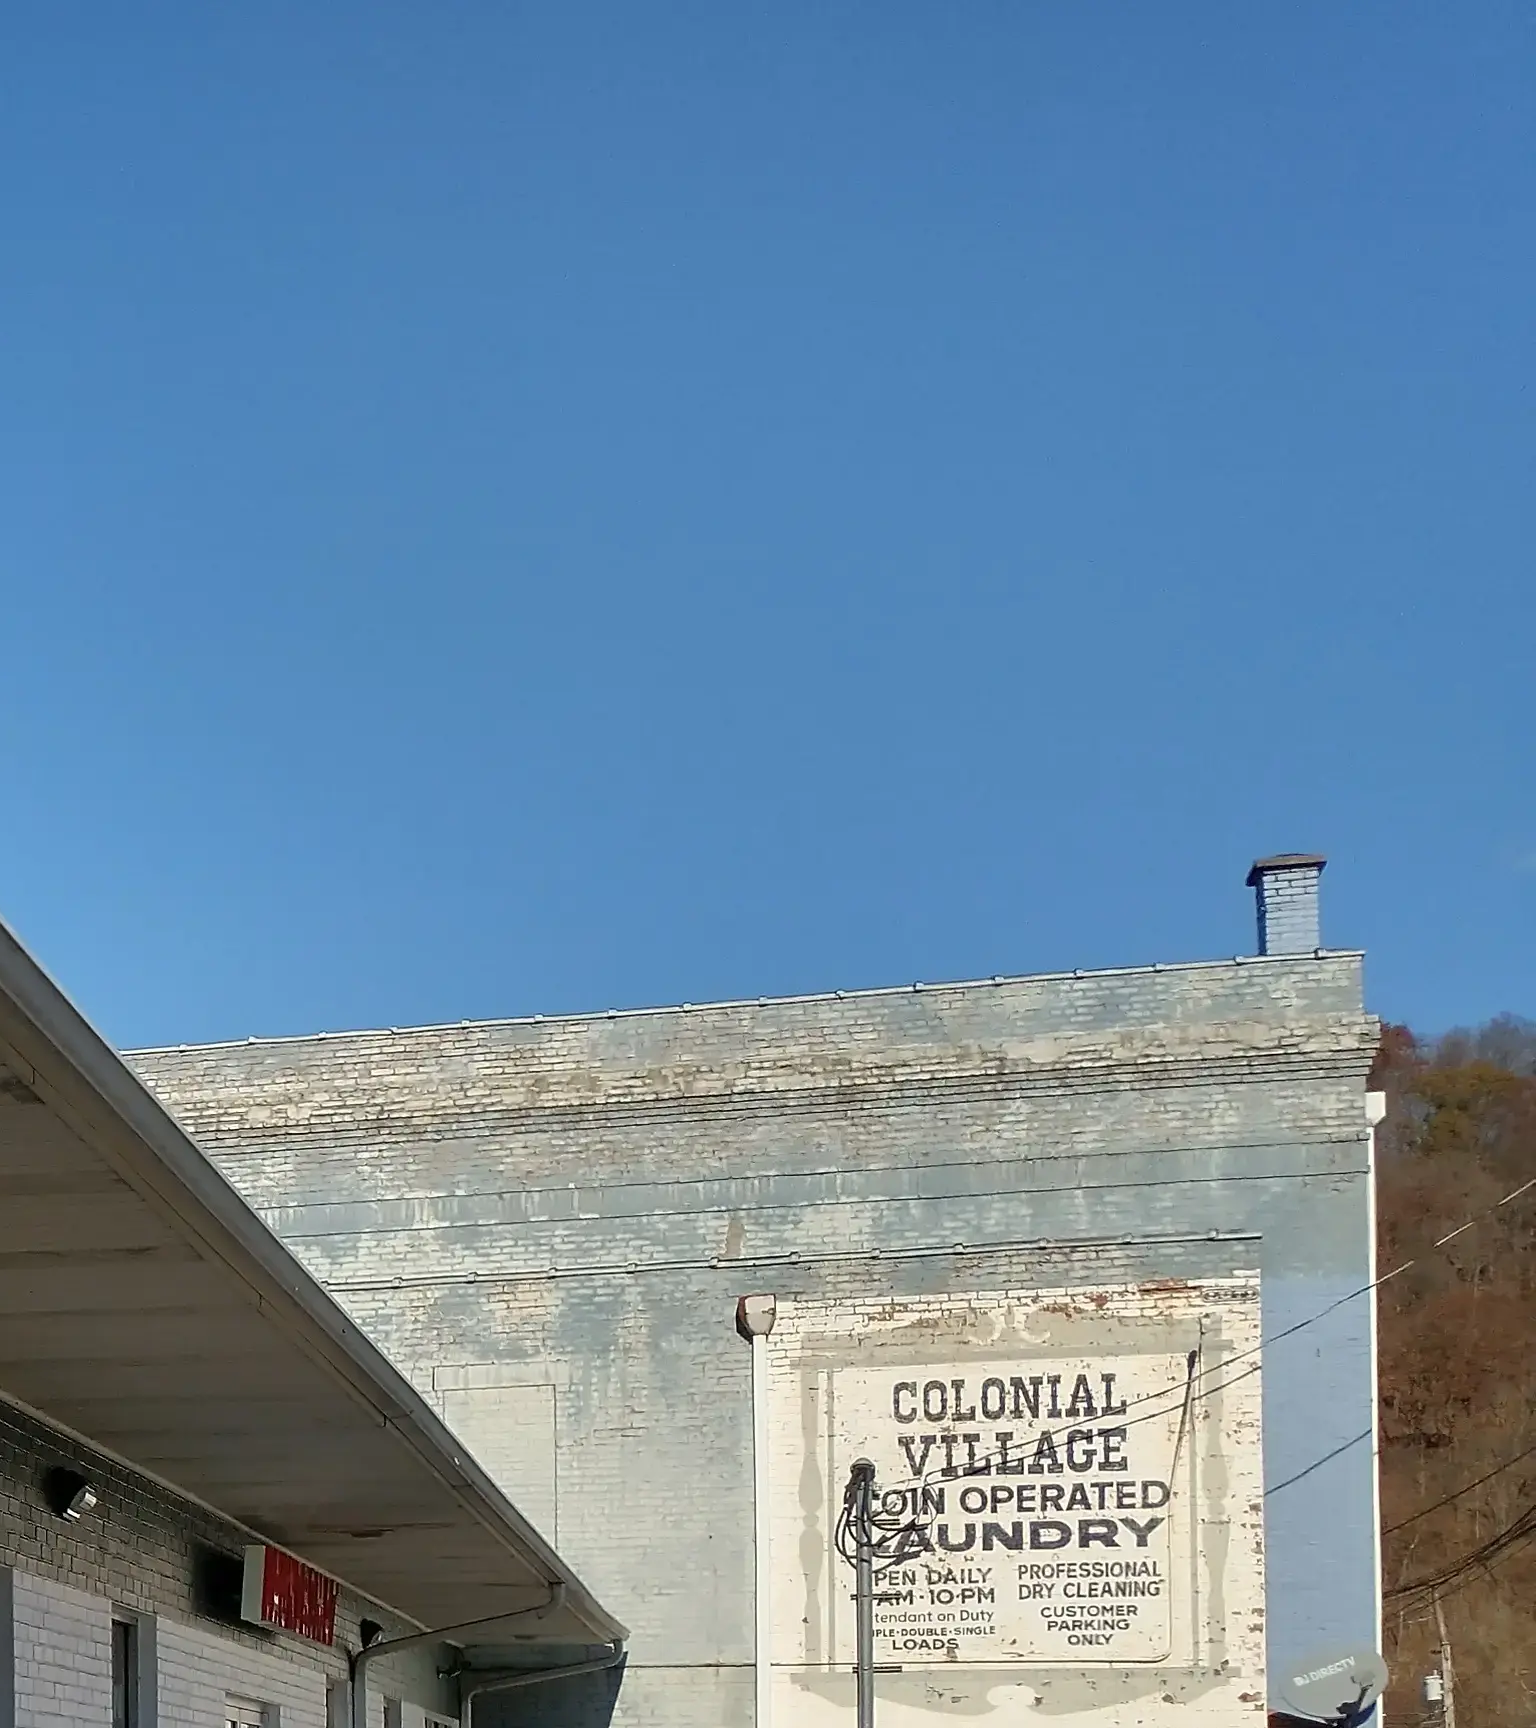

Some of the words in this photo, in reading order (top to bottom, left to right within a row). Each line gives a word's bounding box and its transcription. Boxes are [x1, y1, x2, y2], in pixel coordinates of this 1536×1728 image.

[892, 1373, 1127, 1424] COLONIAL
[897, 1428, 1128, 1477] VILLAGE
[959, 1480, 1171, 1514] OPERATED
[873, 1569, 917, 1586] PEN
[926, 1568, 993, 1586] DAILY
[1017, 1561, 1162, 1580] PROFESSIONAL
[1018, 1583, 1055, 1600] DRY
[1062, 1581, 1162, 1599] CLEANING
[873, 1611, 933, 1624] tendant
[937, 1612, 956, 1622] on
[960, 1609, 994, 1623] Duty
[1040, 1605, 1138, 1618] CUSTOMER
[1047, 1619, 1130, 1632] PARKING
[892, 1637, 960, 1651] LOADS
[1067, 1633, 1114, 1646] ONLY
